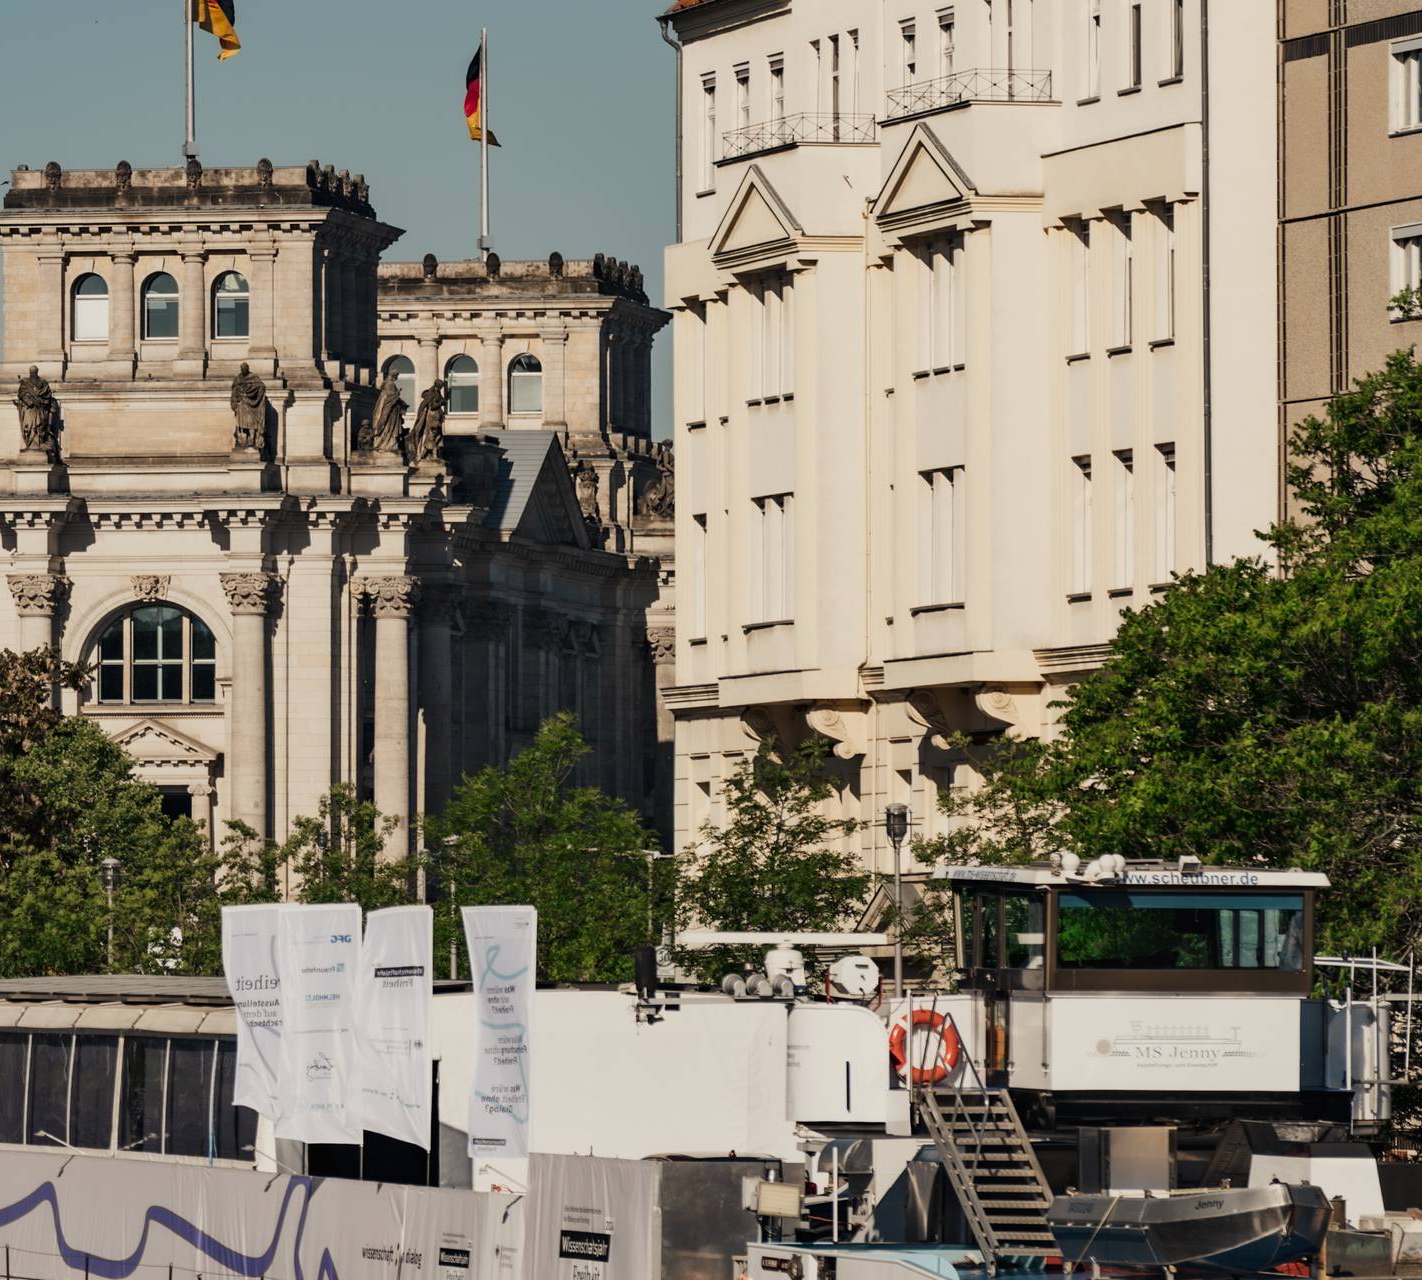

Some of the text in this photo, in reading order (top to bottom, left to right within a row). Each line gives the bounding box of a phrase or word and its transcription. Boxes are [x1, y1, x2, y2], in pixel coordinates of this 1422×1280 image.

[1121, 871, 1259, 885] ww.scheubner.de
[1136, 1046, 1219, 1061] MS Jenny
[1195, 1200, 1225, 1210] Jenny
